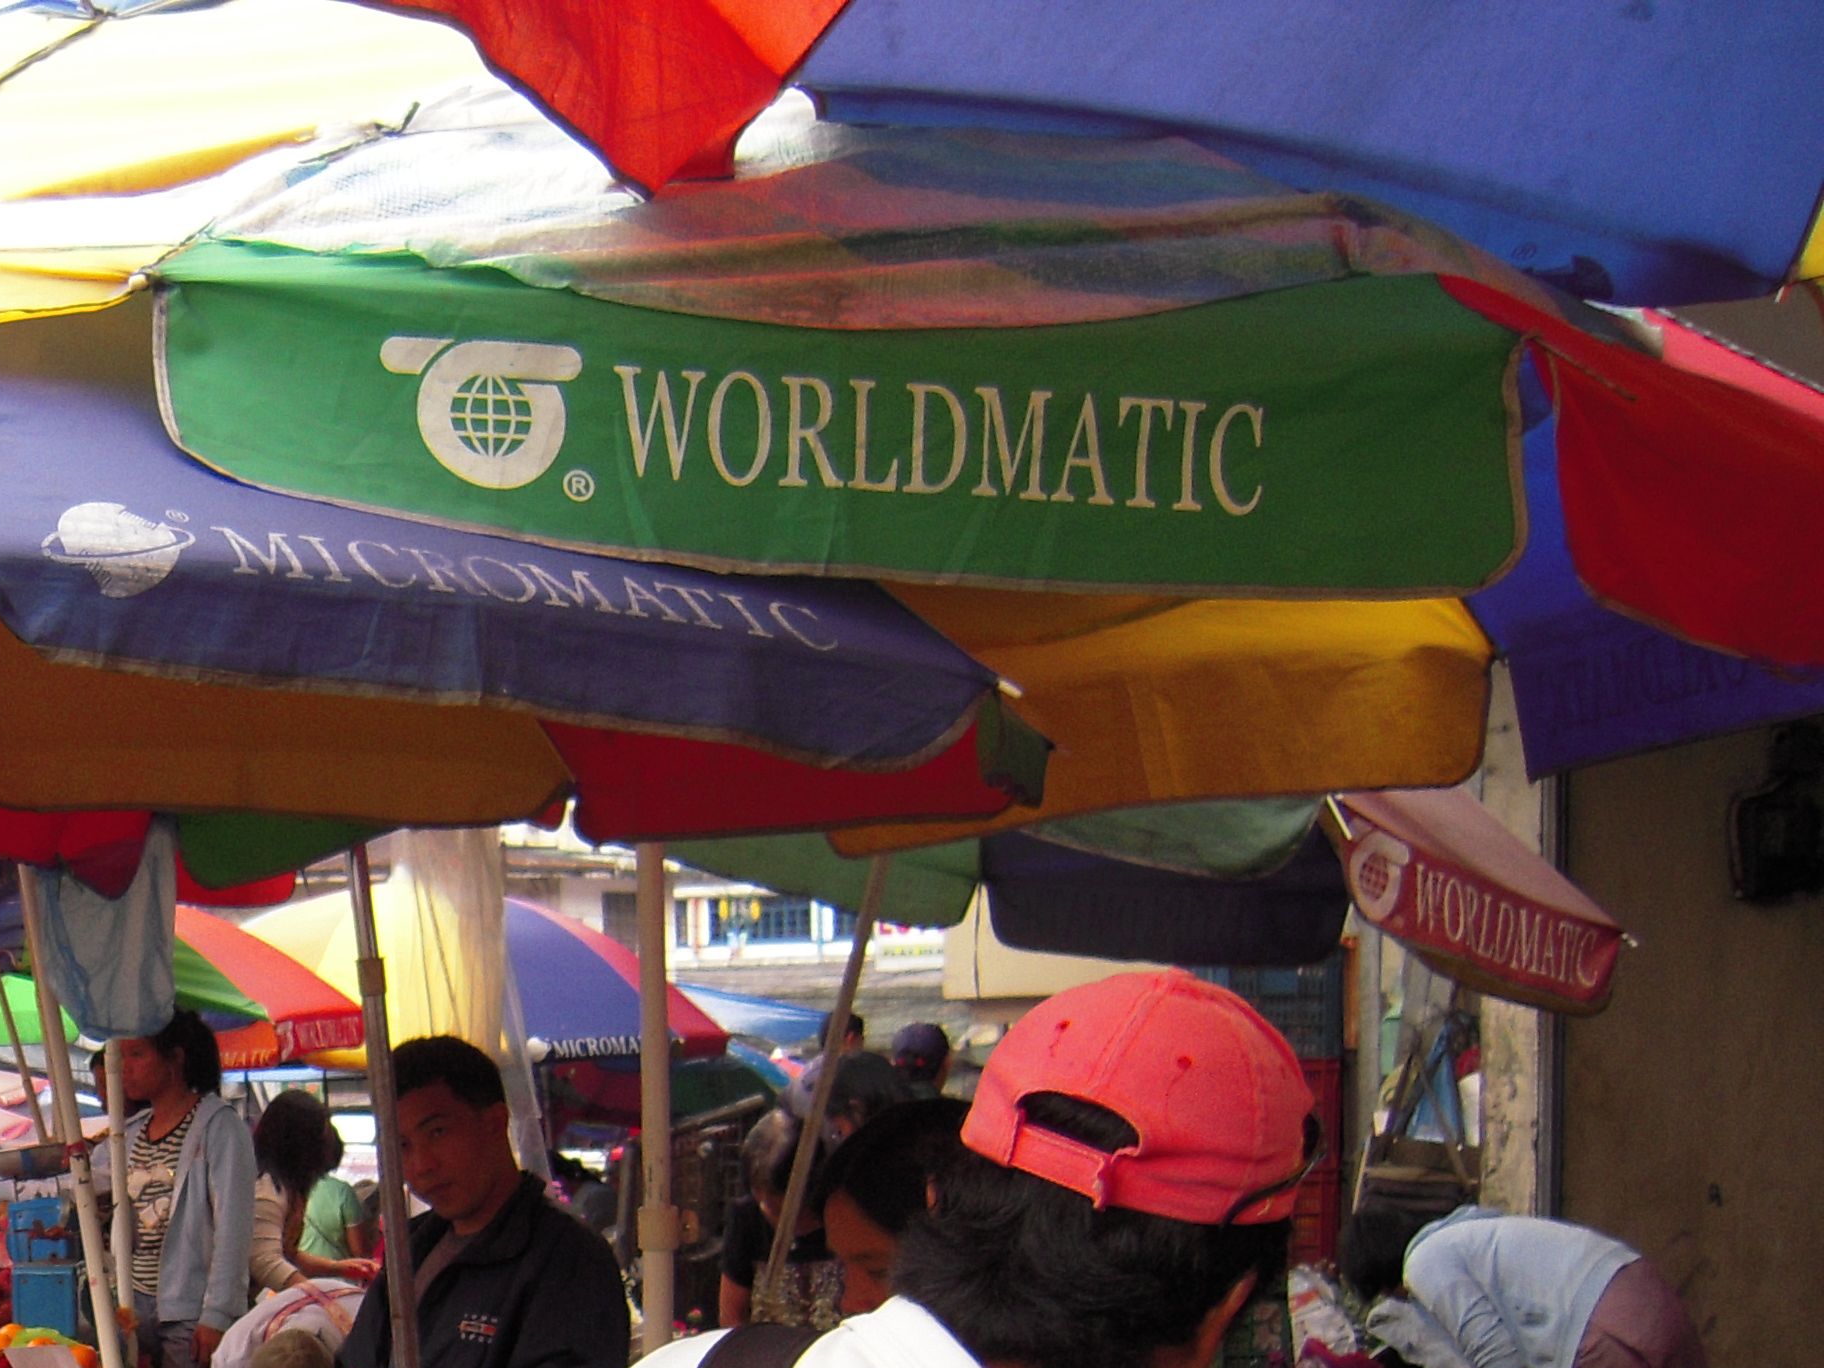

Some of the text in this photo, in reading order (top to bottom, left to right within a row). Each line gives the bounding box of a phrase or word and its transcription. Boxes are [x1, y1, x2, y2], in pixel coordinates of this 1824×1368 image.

[613, 364, 1265, 516] WORLDMATIC
[209, 525, 839, 652] MICROMATIC
[1415, 862, 1599, 989] WORLDMATIC
[553, 1036, 642, 1059] MICROMA
